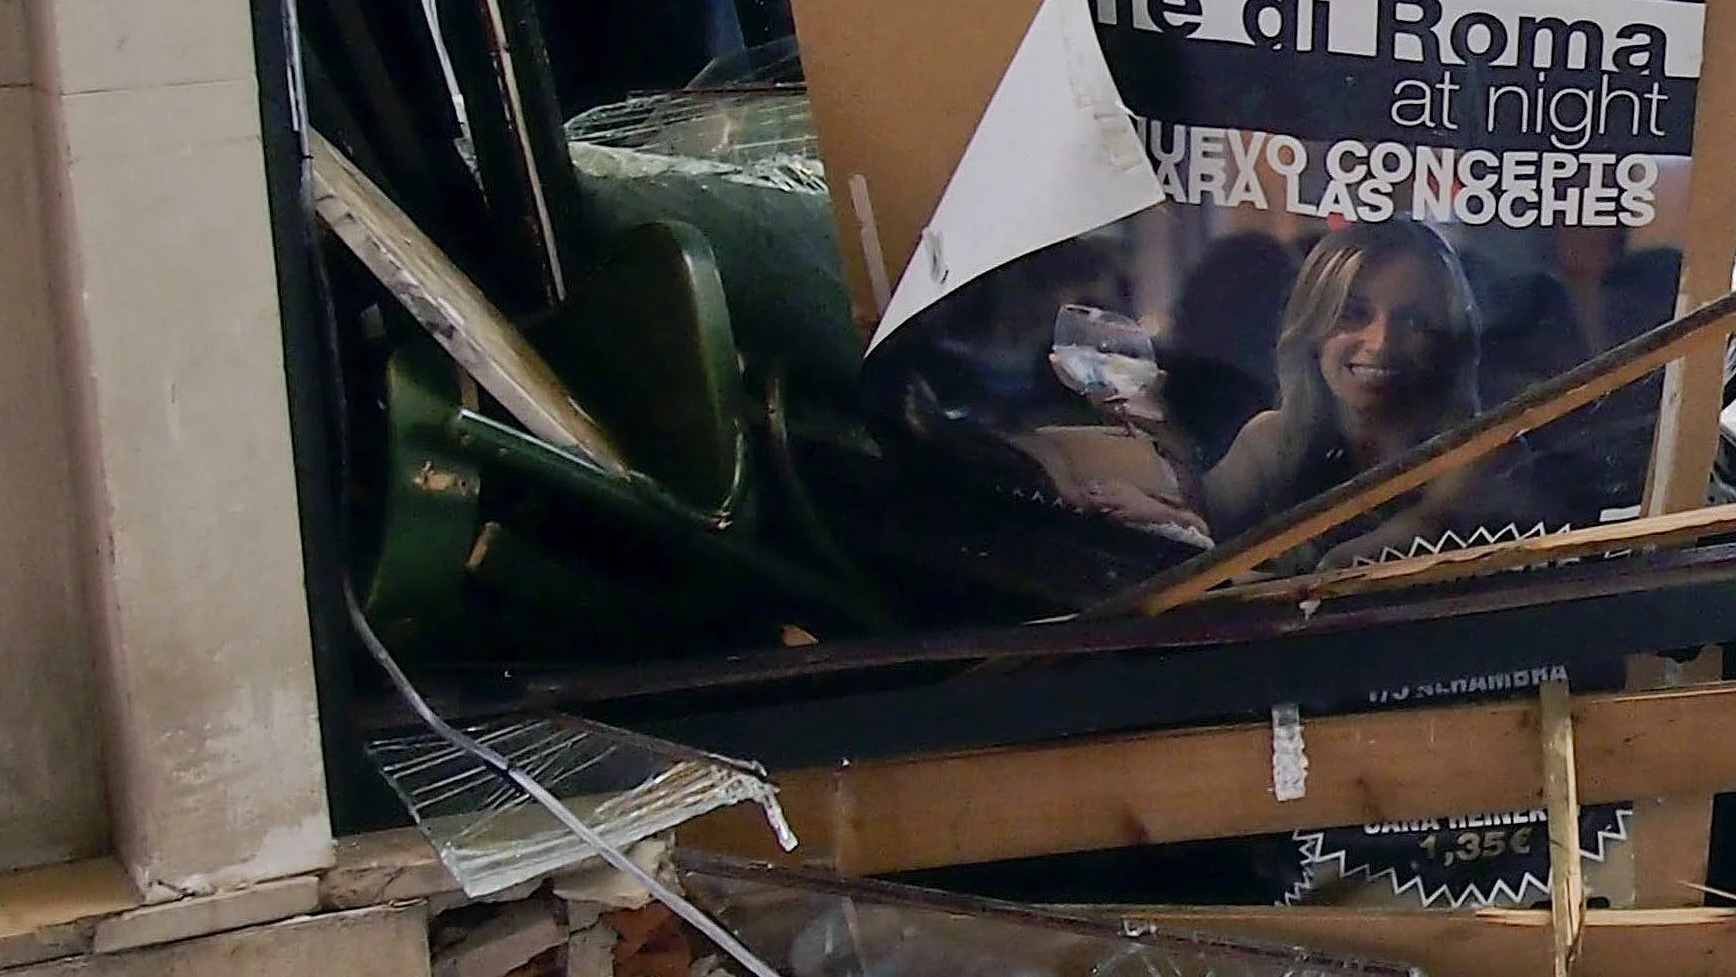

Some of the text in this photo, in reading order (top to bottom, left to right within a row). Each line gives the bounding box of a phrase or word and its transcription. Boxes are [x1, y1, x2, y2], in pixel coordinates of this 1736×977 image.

[1390, 70, 1669, 150] at night
[1325, 139, 1659, 193] CONCEPTO
[1286, 171, 1395, 223] LAS
[1412, 179, 1656, 228] NOCHES
